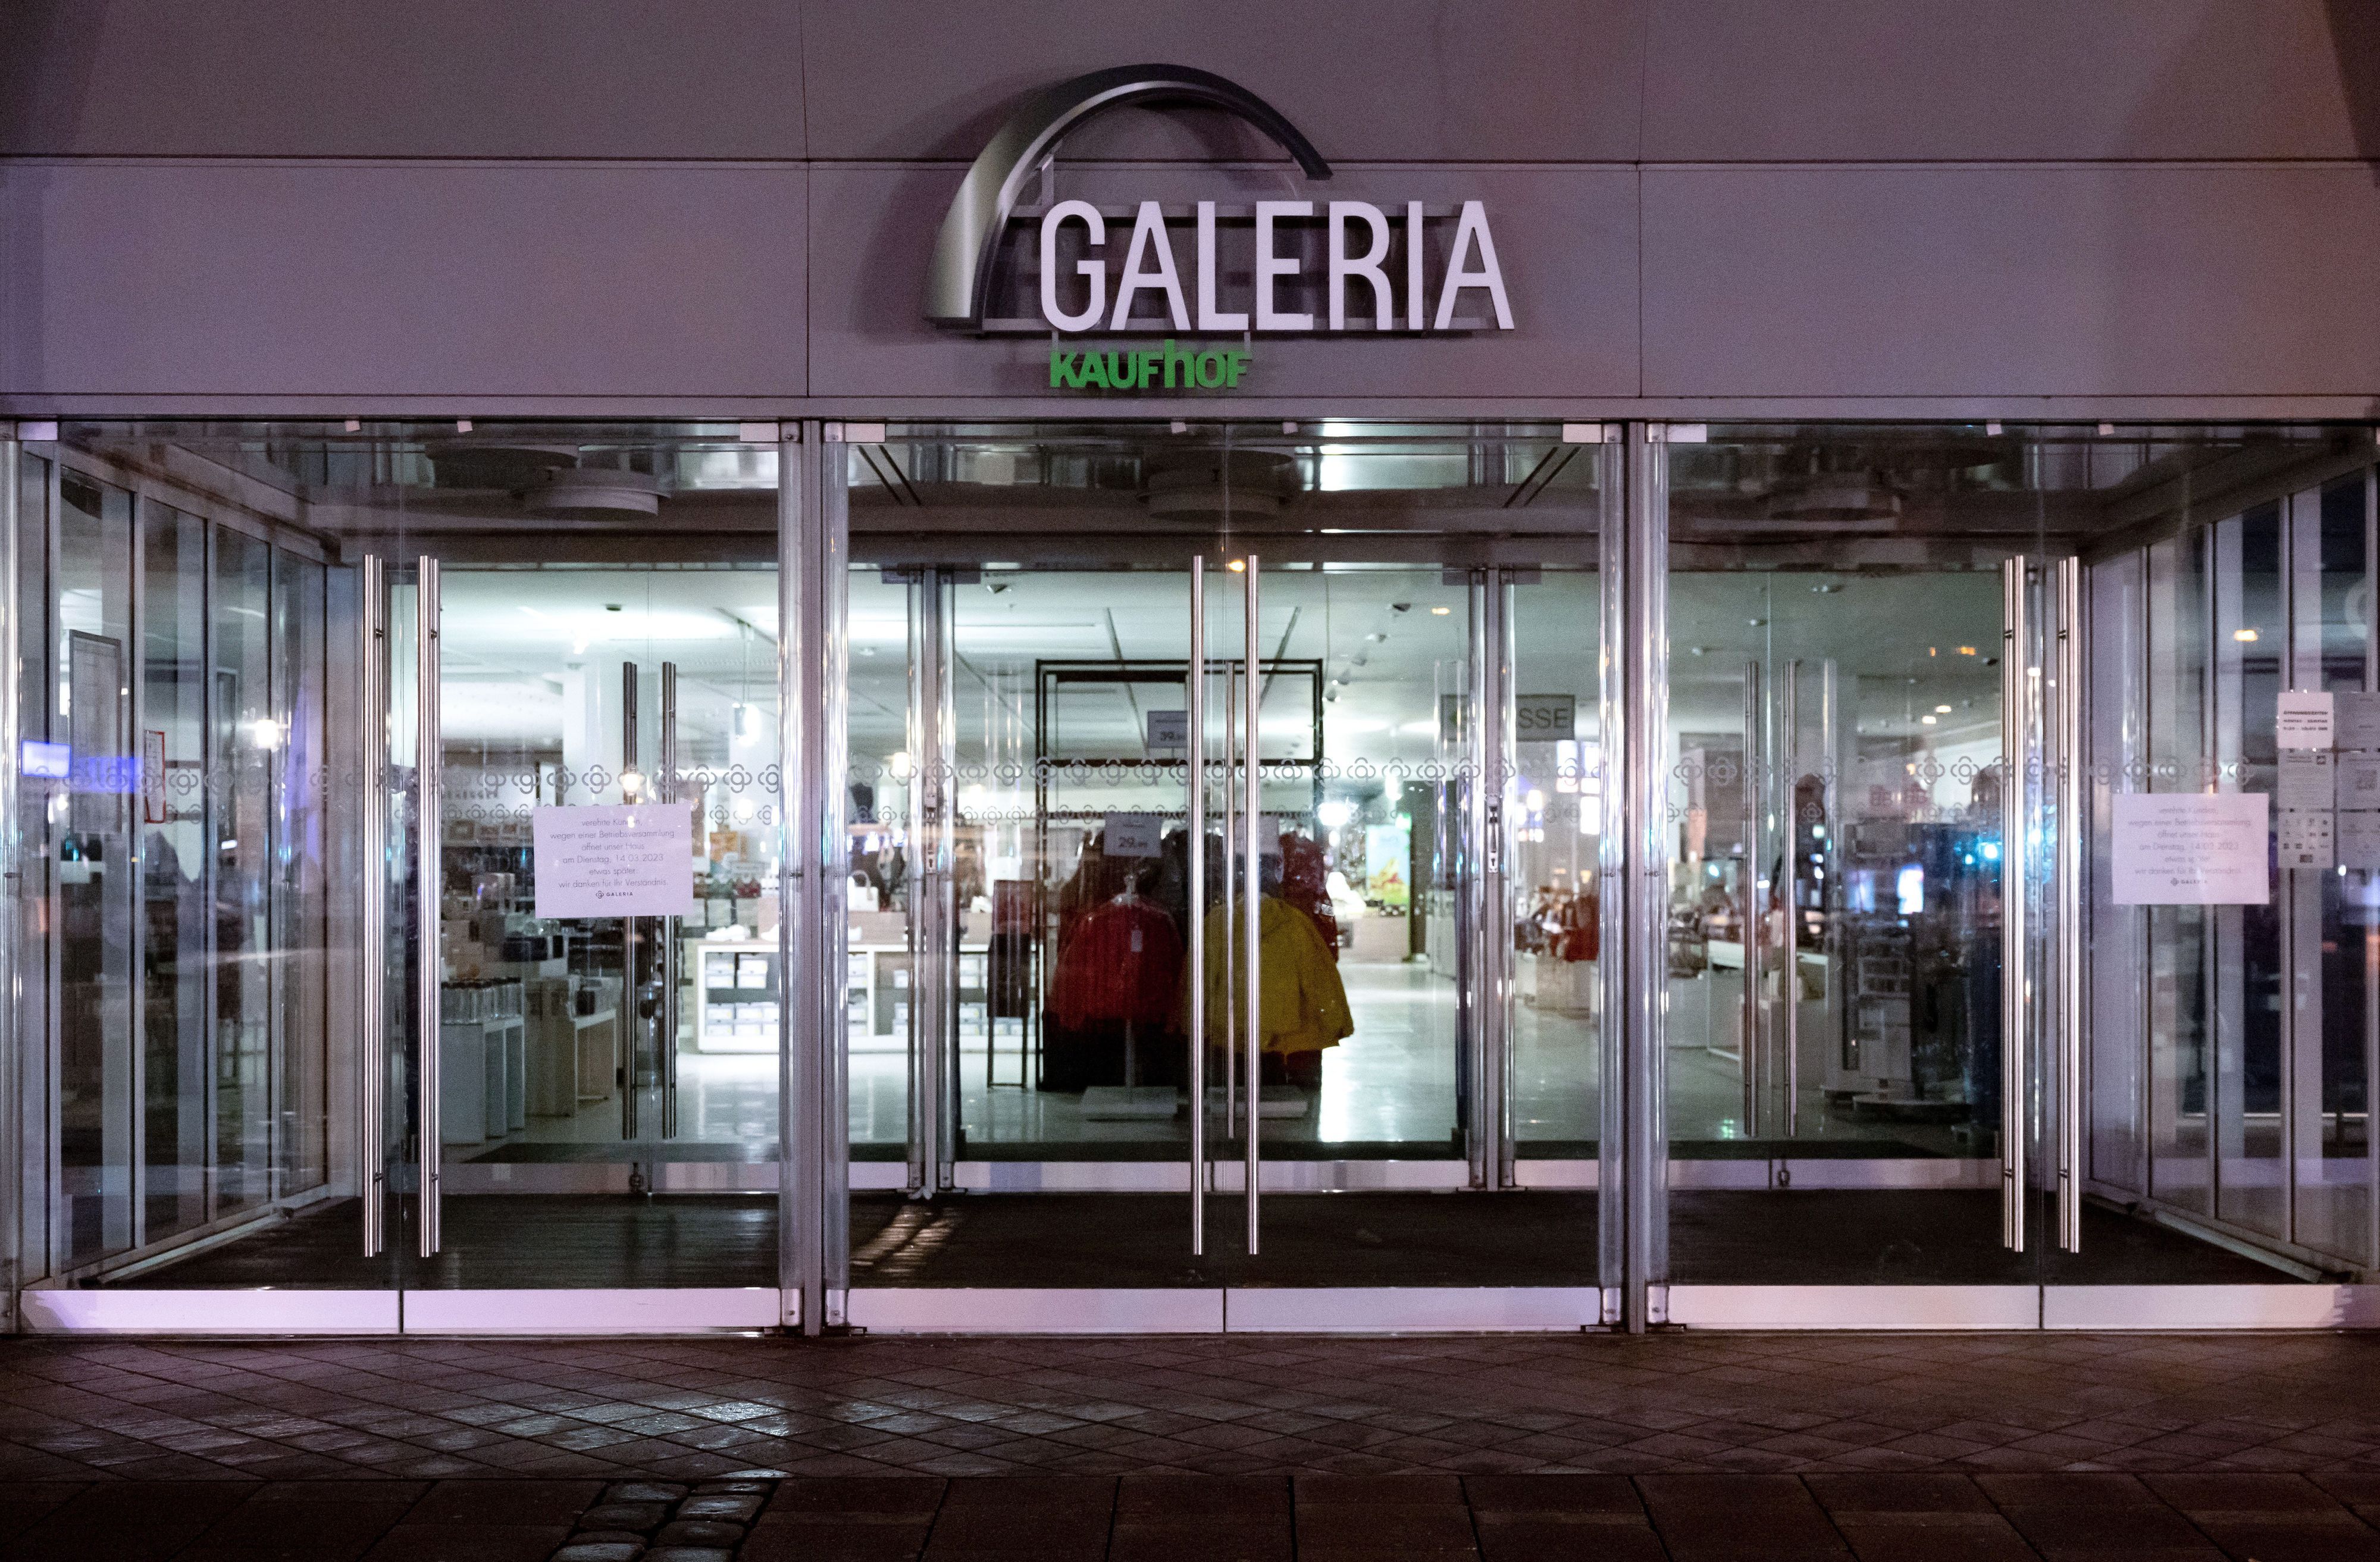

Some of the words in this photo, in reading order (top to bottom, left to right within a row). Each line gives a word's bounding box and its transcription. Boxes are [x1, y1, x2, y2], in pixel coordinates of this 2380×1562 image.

[1040, 201, 1514, 331] GALERIA
[582, 818, 610, 827] verehrte
[550, 833, 575, 841] wegen
[599, 829, 675, 839] Betriebsversammlung
[582, 842, 602, 851] öffnet
[577, 855, 612, 865] Dienstag,
[613, 867, 638, 876] später.
[572, 879, 600, 888] danken
[602, 878, 611, 887] für
[614, 878, 623, 887] Ihr
